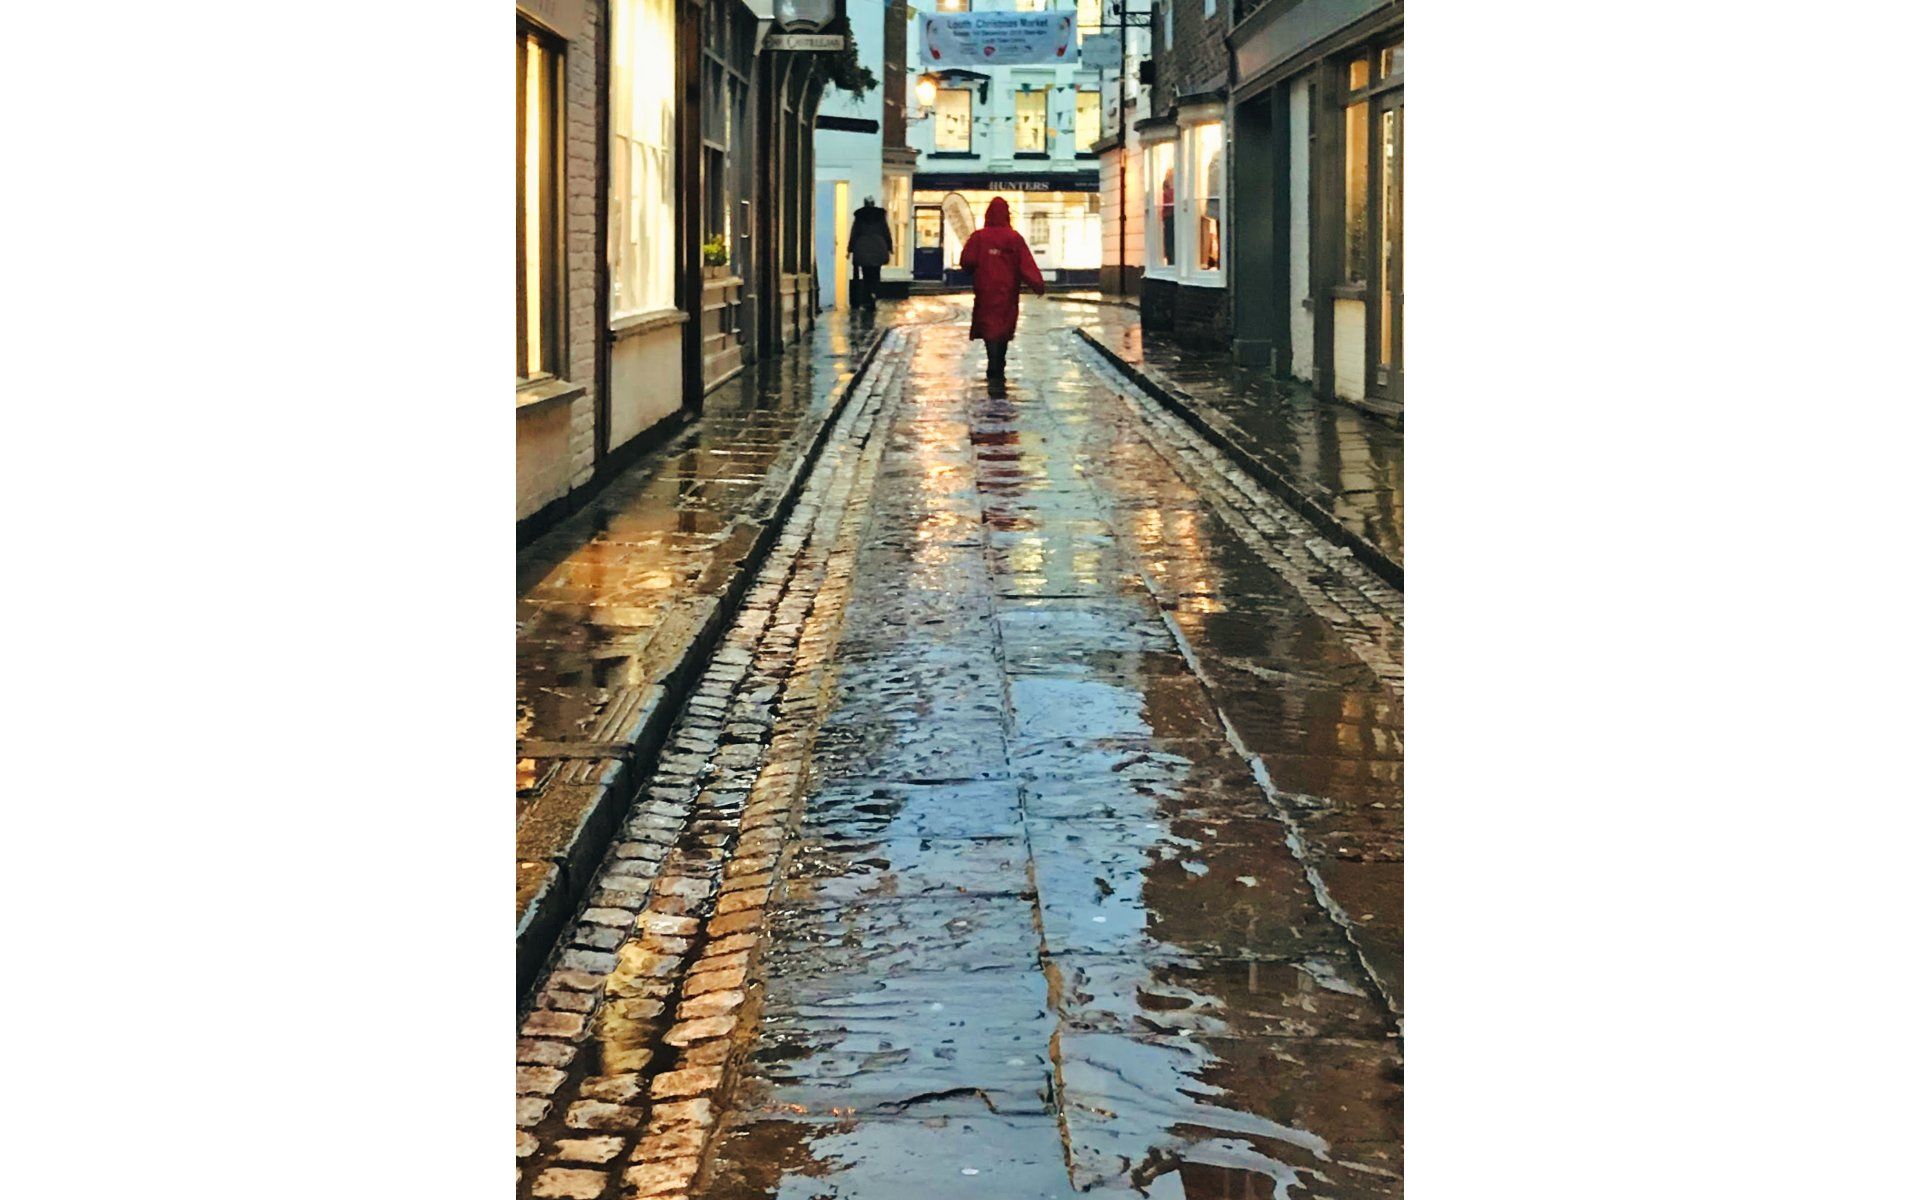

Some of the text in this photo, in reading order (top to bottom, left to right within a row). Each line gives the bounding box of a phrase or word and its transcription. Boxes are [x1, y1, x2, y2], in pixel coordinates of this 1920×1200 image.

[976, 19, 1018, 28] Christmas
[1020, 18, 1048, 27] Market
[989, 181, 1050, 191] HUNTERS
